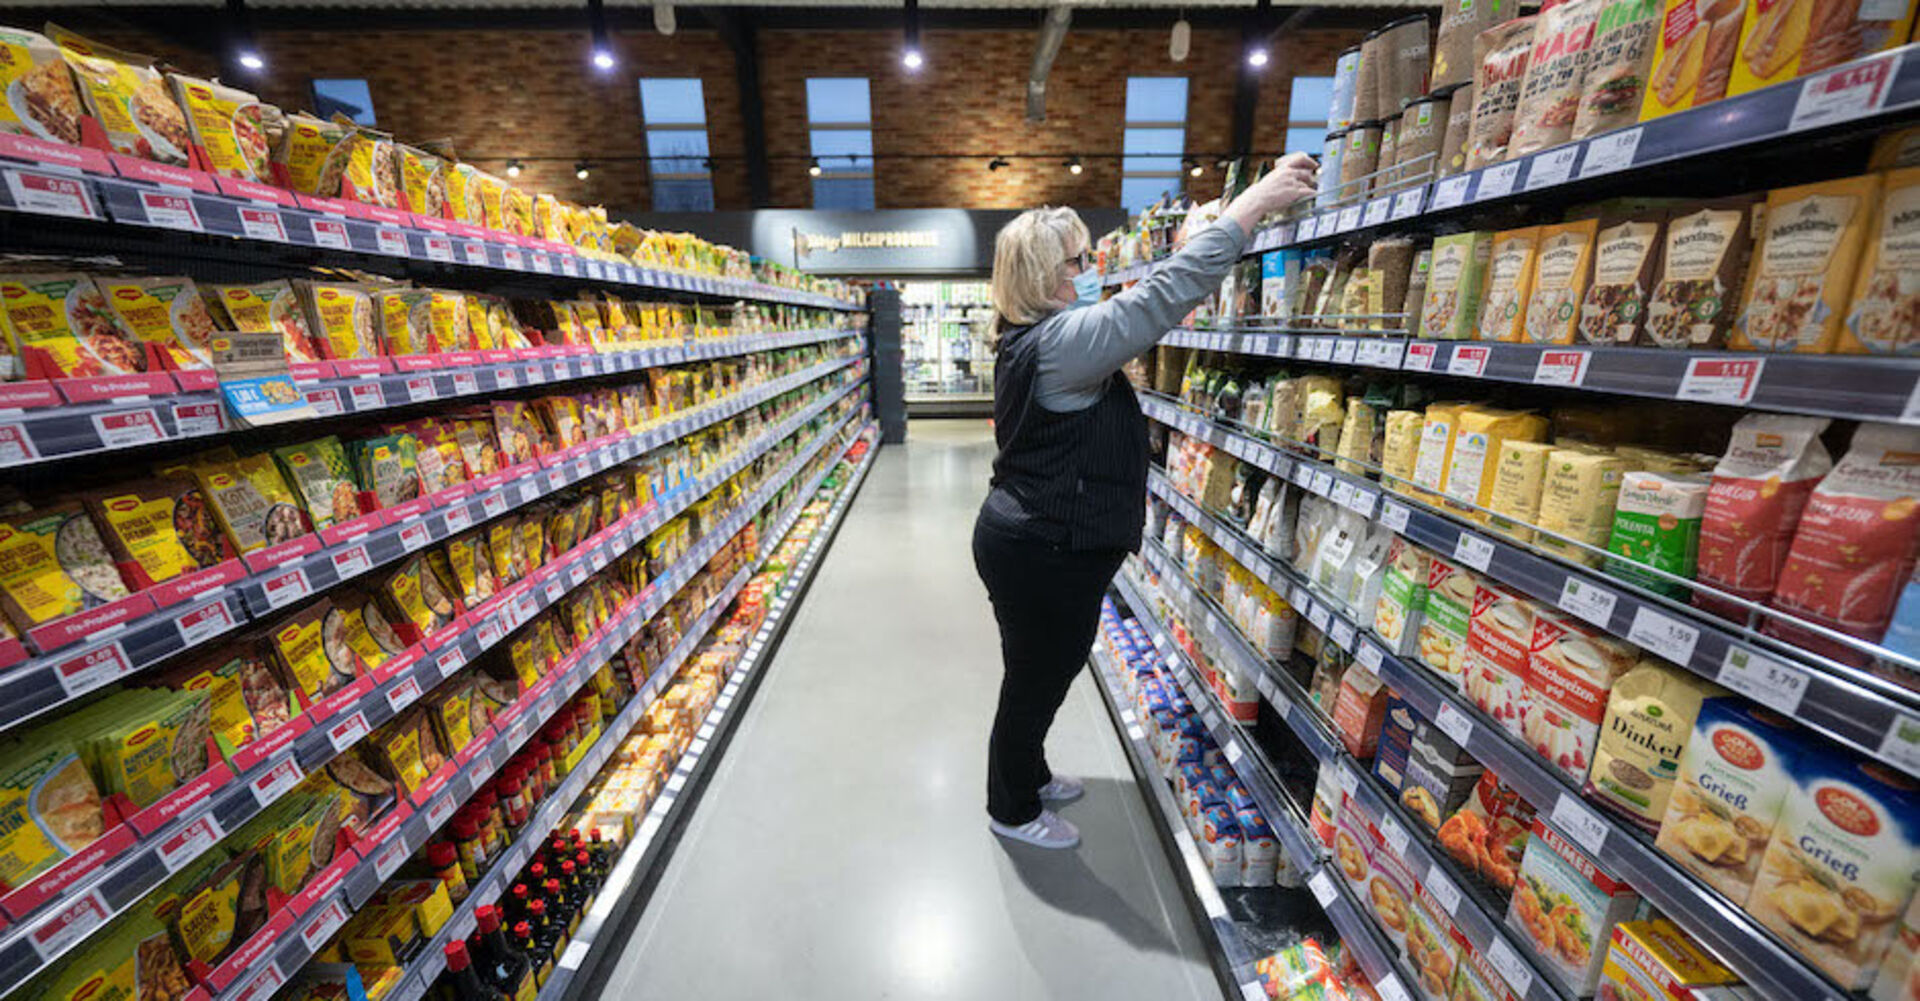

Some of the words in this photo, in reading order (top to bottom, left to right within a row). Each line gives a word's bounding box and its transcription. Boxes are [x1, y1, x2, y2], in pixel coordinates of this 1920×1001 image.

[1615, 517, 1655, 536] POLENTA
[1612, 716, 1682, 760] Dinkel
[1699, 773, 1749, 812] Grieß
[1542, 828, 1597, 882] LEIMER
[1799, 835, 1860, 882] Grieß
[1620, 934, 1670, 988] LEIMER
